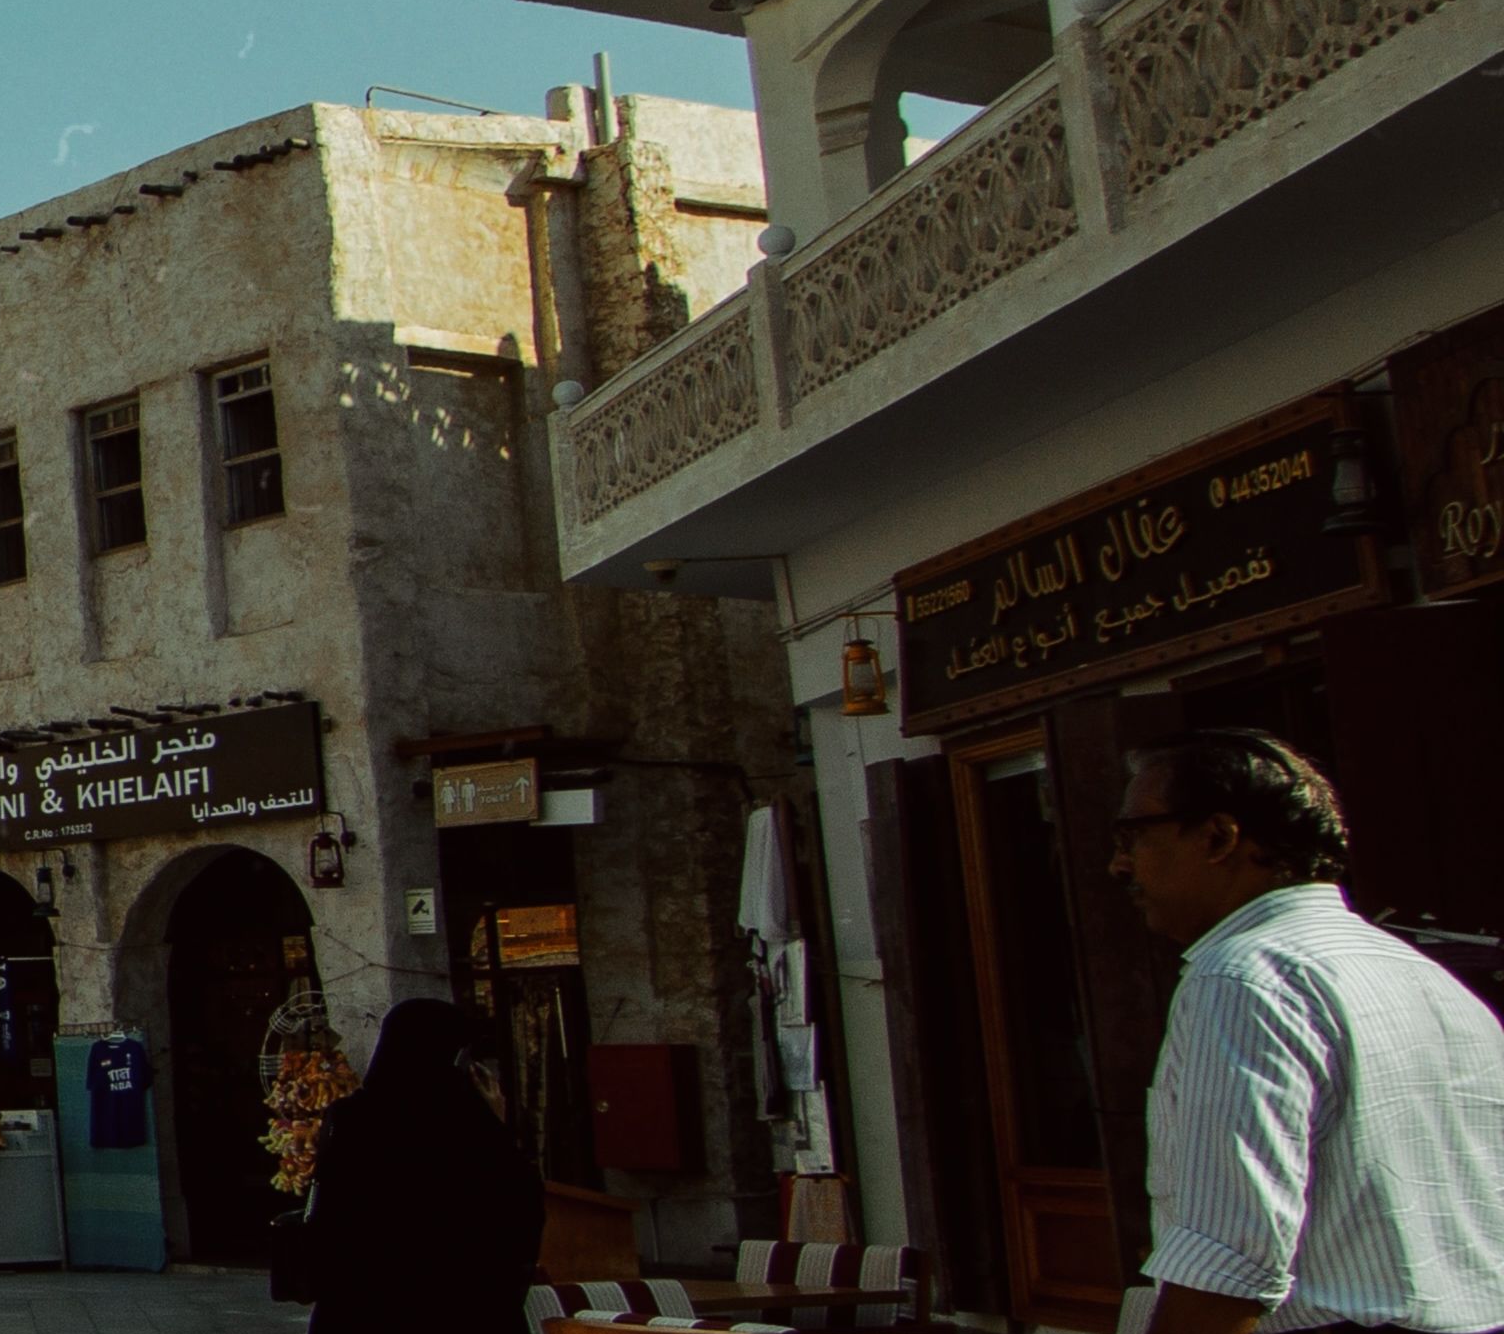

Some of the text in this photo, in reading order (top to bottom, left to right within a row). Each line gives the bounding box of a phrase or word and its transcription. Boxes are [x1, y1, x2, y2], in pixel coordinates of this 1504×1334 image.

[35, 735, 137, 788] الخليفي
[151, 727, 216, 765] متجر
[40, 788, 64, 815] &
[78, 766, 210, 810] KHELAIFI
[191, 788, 315, 823] للتحف والهدايا
